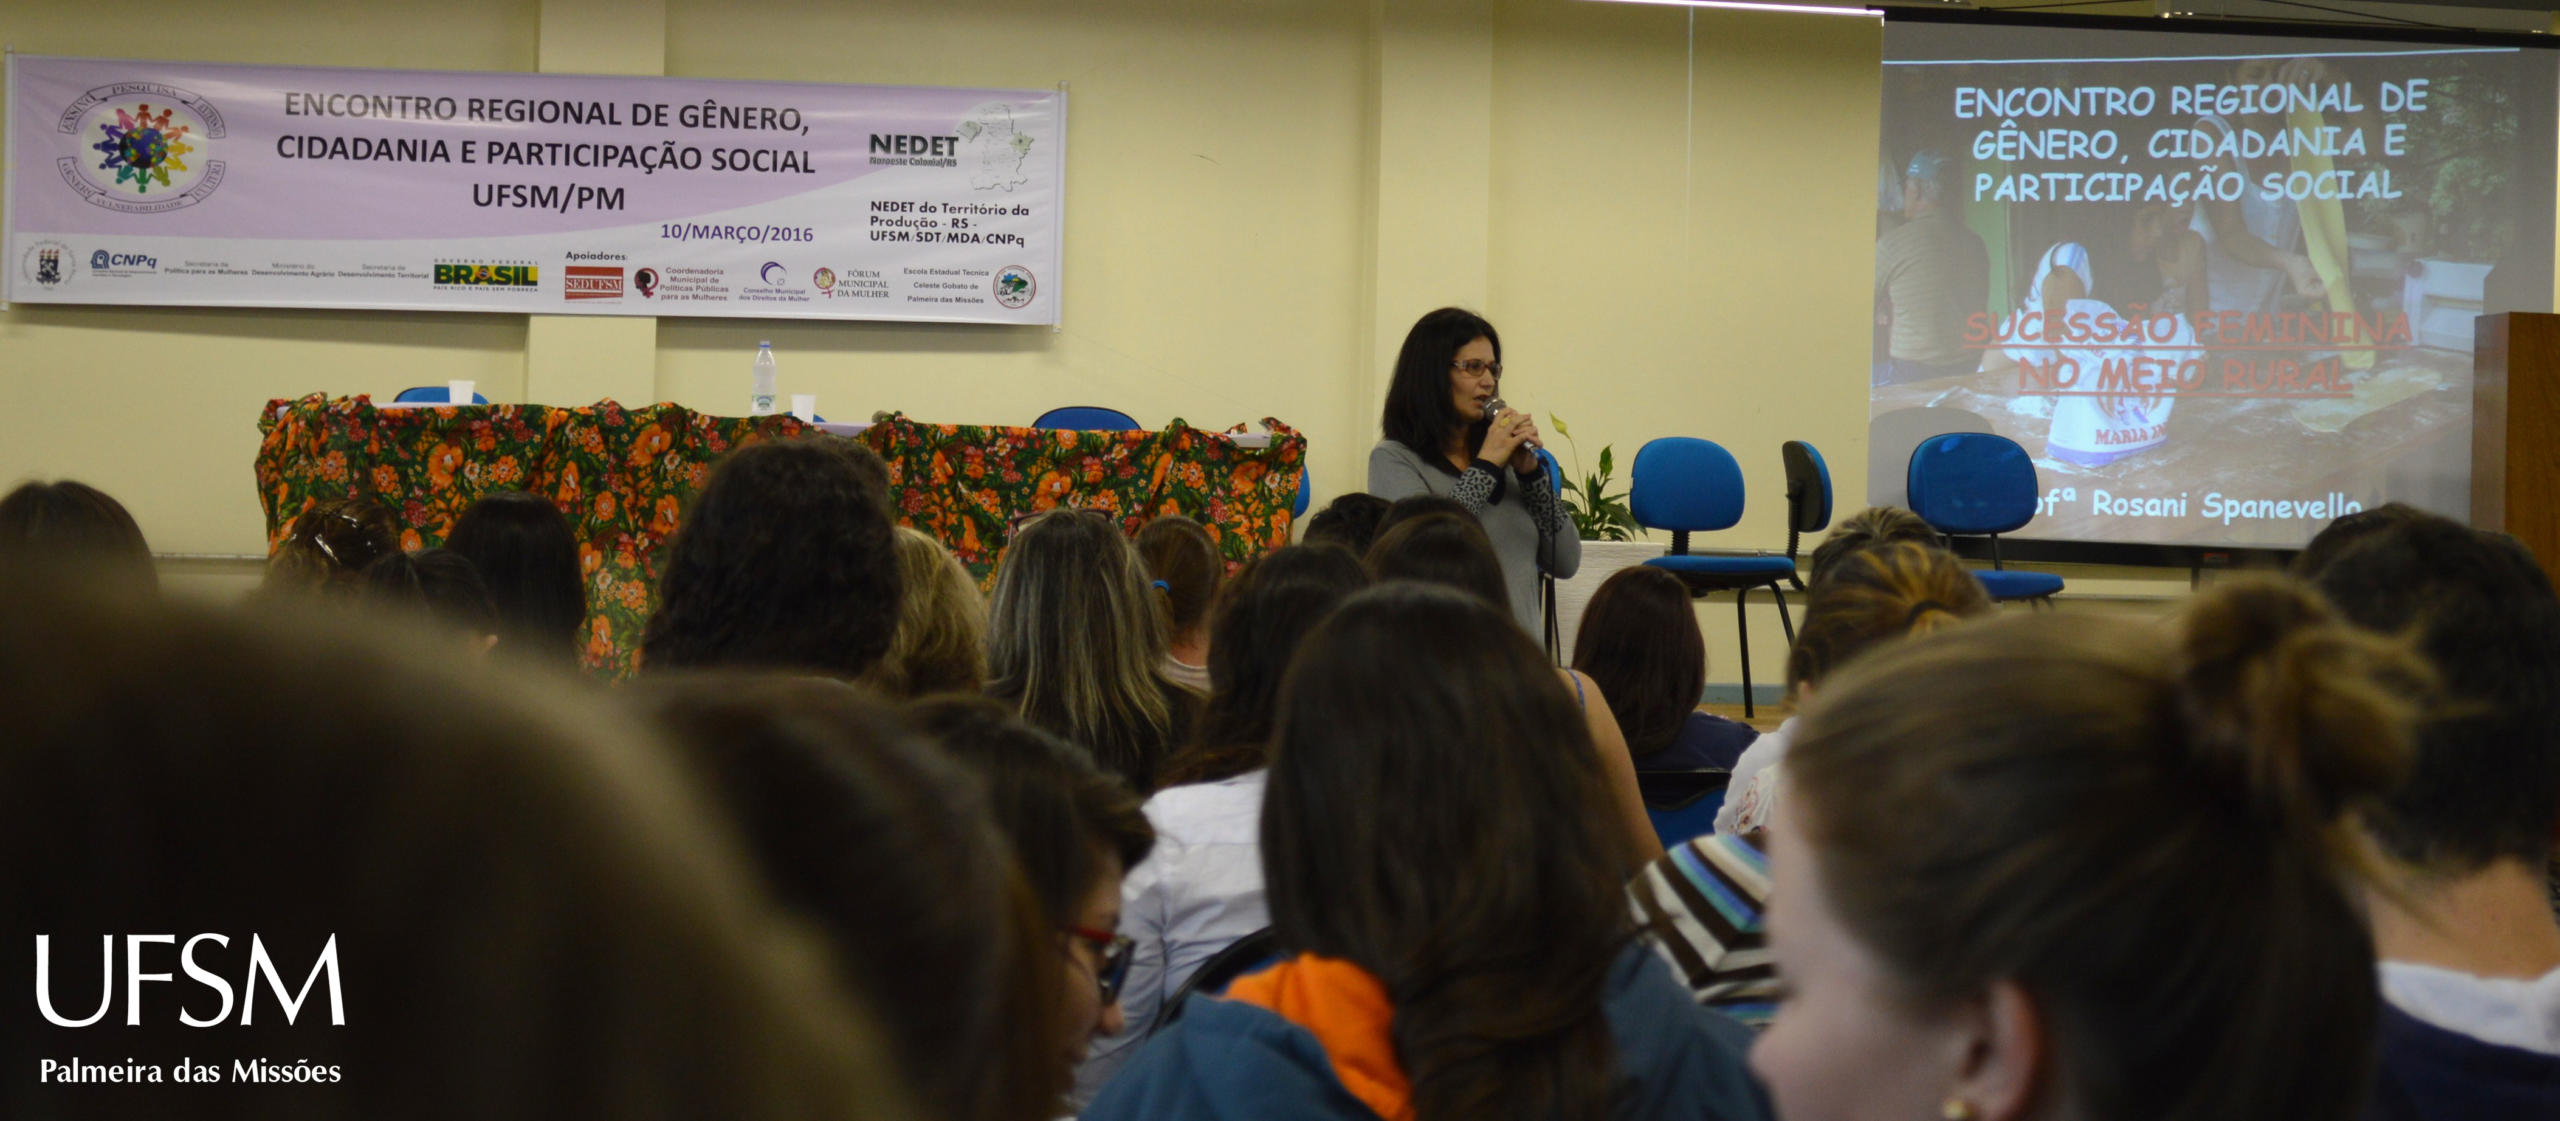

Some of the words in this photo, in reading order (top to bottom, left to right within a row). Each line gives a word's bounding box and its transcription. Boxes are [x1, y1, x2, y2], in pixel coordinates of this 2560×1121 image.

[1955, 86, 2156, 118] ENCONTRO
[2171, 81, 2364, 115] REGIONAL
[2381, 78, 2430, 113] DE
[285, 92, 457, 121] ENCONTRO
[468, 98, 622, 125] REGIONAL
[632, 103, 669, 127] DE
[679, 99, 809, 136] GÊNERO,
[869, 133, 959, 157] NEDET
[1972, 118, 2129, 165] GÊNERO,
[2148, 126, 2367, 159] CIDADANIA
[2384, 123, 2407, 156] E
[276, 134, 451, 164] CIDADANIA
[461, 140, 476, 164] E
[487, 140, 702, 175] PARTICIPAÇÃO
[711, 147, 816, 174] SOCIAL
[869, 156, 908, 166] Noroeste
[909, 157, 958, 168] Colonial/RS
[1975, 165, 2245, 207] PARTICIPAÇÃO
[2260, 169, 2402, 200] SOCIAL
[472, 182, 625, 214] UFSM/PM
[870, 201, 915, 213] NEDET
[919, 201, 937, 214] do
[941, 203, 1007, 216] Território
[1011, 204, 1029, 216] da
[870, 216, 938, 231] Produção
[951, 218, 969, 229] RS
[660, 222, 814, 244] 10/MARÇO/2016
[111, 254, 158, 269] CNPq
[433, 264, 538, 286] BRASIL
[665, 266, 725, 276] Coordenadoria
[847, 268, 881, 278] FÓRUM
[903, 267, 928, 275] Escola
[929, 268, 961, 276] Estadual
[565, 278, 623, 291] SEDUFSM
[670, 276, 708, 285] Municipal
[837, 279, 889, 289] MUNICIPAL
[913, 281, 940, 289] Celeste
[969, 282, 979, 290] de
[660, 293, 680, 302] para
[691, 294, 728, 302] Mulheres
[837, 290, 853, 298] DA
[855, 290, 890, 298] MULHER
[907, 295, 939, 303] Palmeira
[1963, 303, 2178, 344] SUCESSÃO
[2195, 310, 2413, 344] FEMININA
[2018, 356, 2081, 390] NO
[2097, 356, 2203, 391] MEIO
[2223, 359, 2353, 392] RURAL
[2092, 490, 2187, 517] Rosani
[2201, 492, 2362, 526] Spanevello
